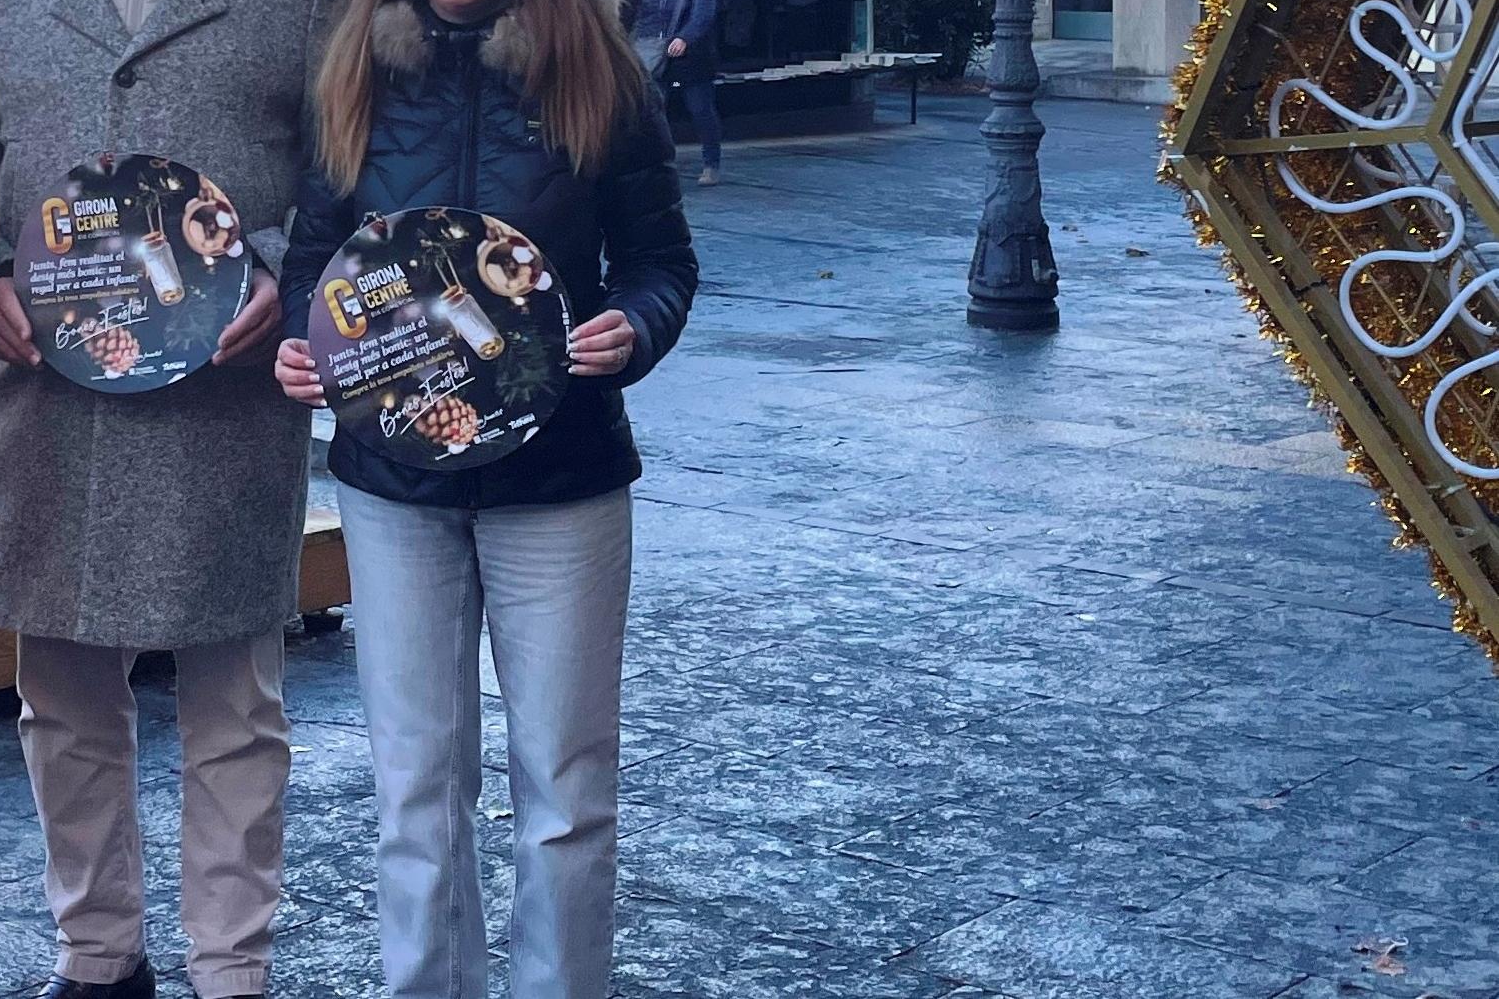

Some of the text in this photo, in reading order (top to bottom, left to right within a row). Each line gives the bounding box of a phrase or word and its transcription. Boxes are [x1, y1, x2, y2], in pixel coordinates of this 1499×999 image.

[73, 197, 118, 217] GIRONA
[76, 212, 120, 232] CENTRE
[79, 253, 114, 266] realitat
[115, 250, 125, 262] el
[108, 265, 122, 274] un
[31, 282, 55, 296] regal
[56, 282, 73, 294] per
[73, 281, 80, 290] a
[81, 277, 104, 289] cada
[356, 262, 406, 293] GIRONA
[363, 277, 412, 309] CENTRE
[358, 338, 379, 355] fem
[379, 321, 417, 343] realitat
[417, 315, 428, 329] el
[333, 360, 360, 377] desig
[361, 349, 381, 366] més
[413, 331, 429, 343] un
[337, 370, 363, 388] regal
[364, 364, 381, 380] per
[381, 362, 390, 371] a
[390, 351, 415, 367] cada
[379, 397, 421, 438] Bones
